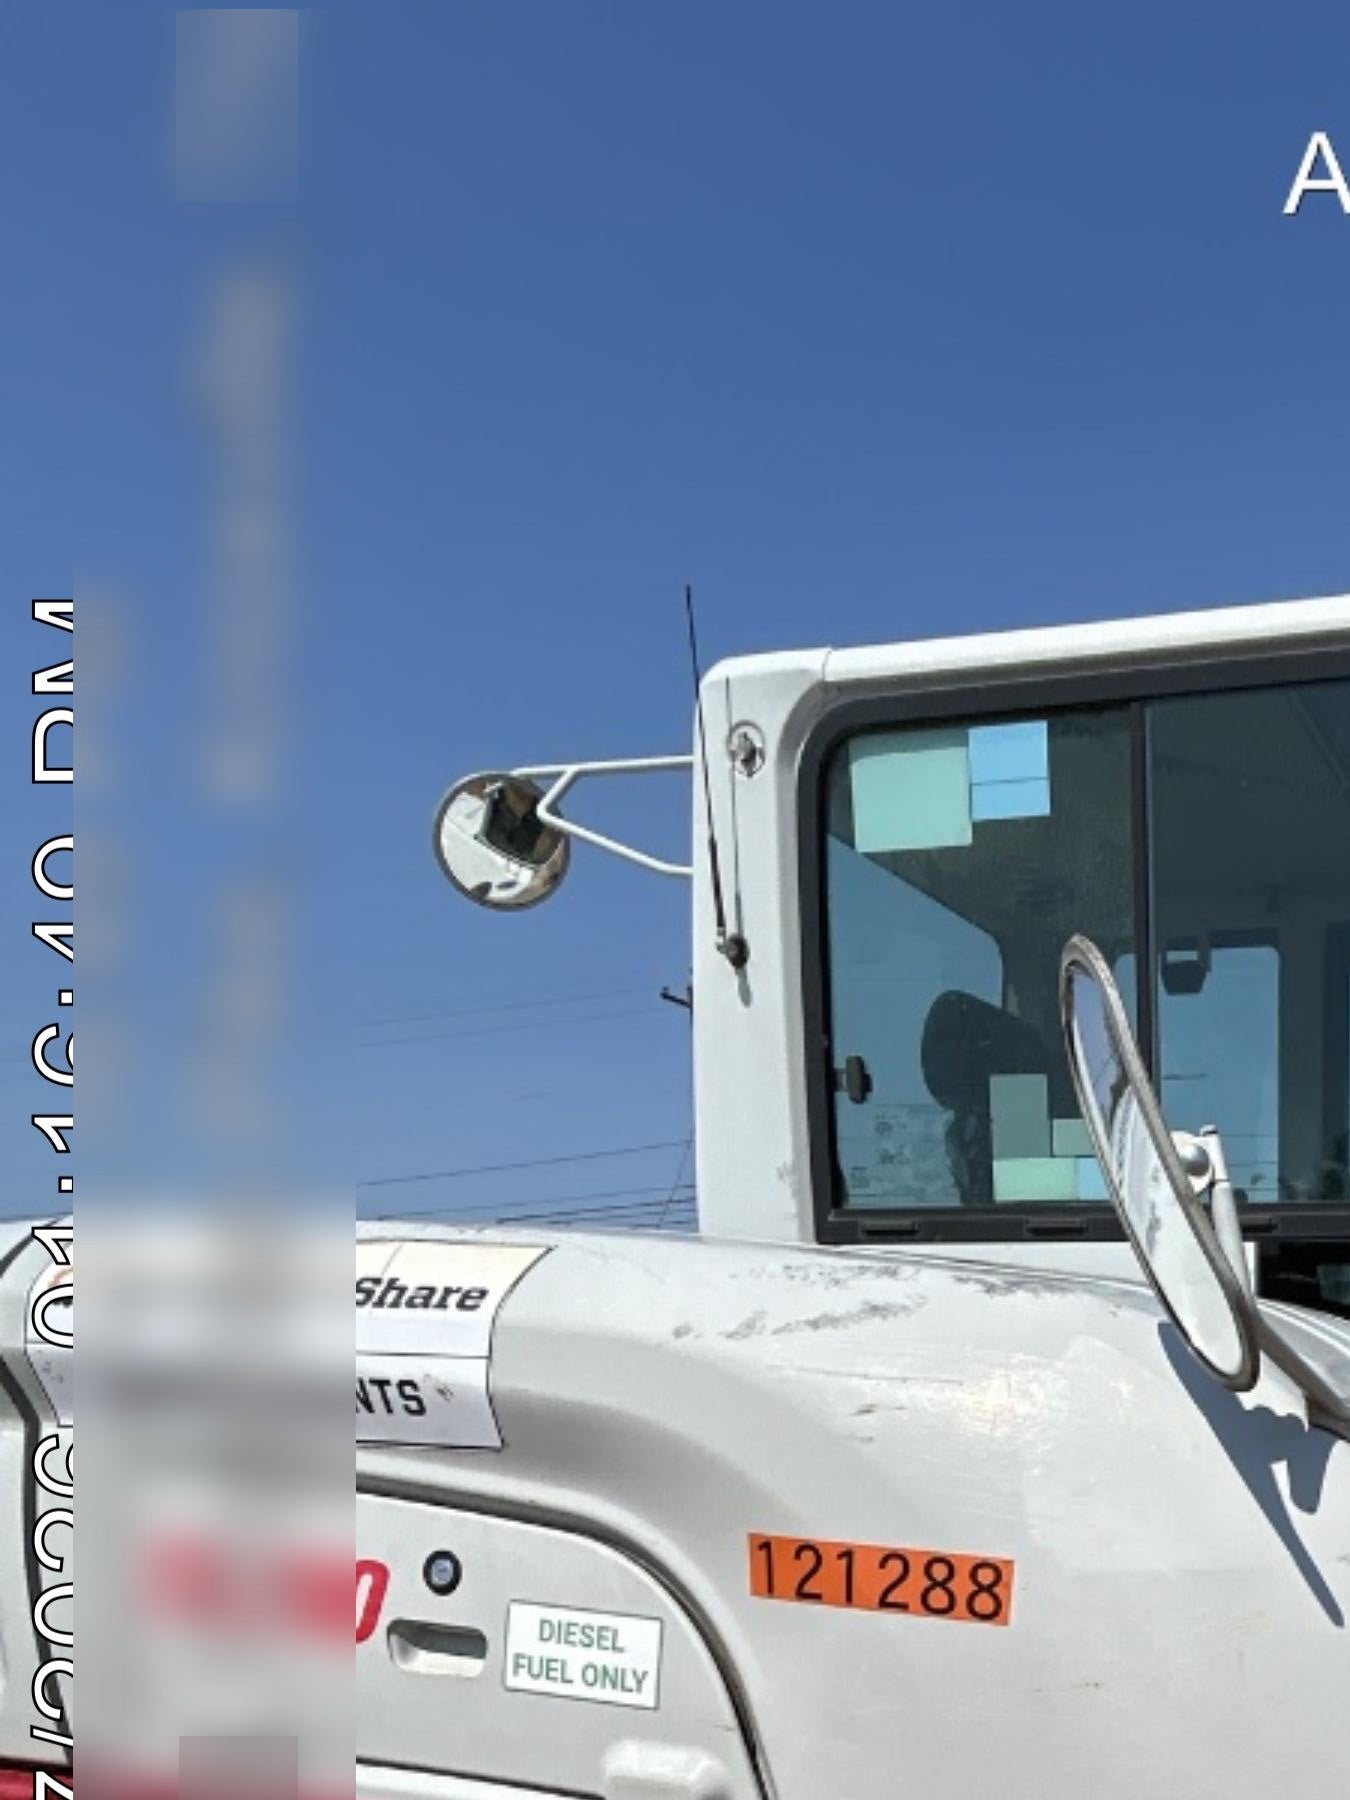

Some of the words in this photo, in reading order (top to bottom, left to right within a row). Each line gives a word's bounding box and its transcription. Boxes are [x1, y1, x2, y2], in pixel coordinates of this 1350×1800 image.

[757, 1539, 1004, 1621] 121288
[538, 1617, 625, 1654] DIESEL
[512, 1651, 574, 1685] FUEL
[581, 1661, 649, 1695] ONLY
